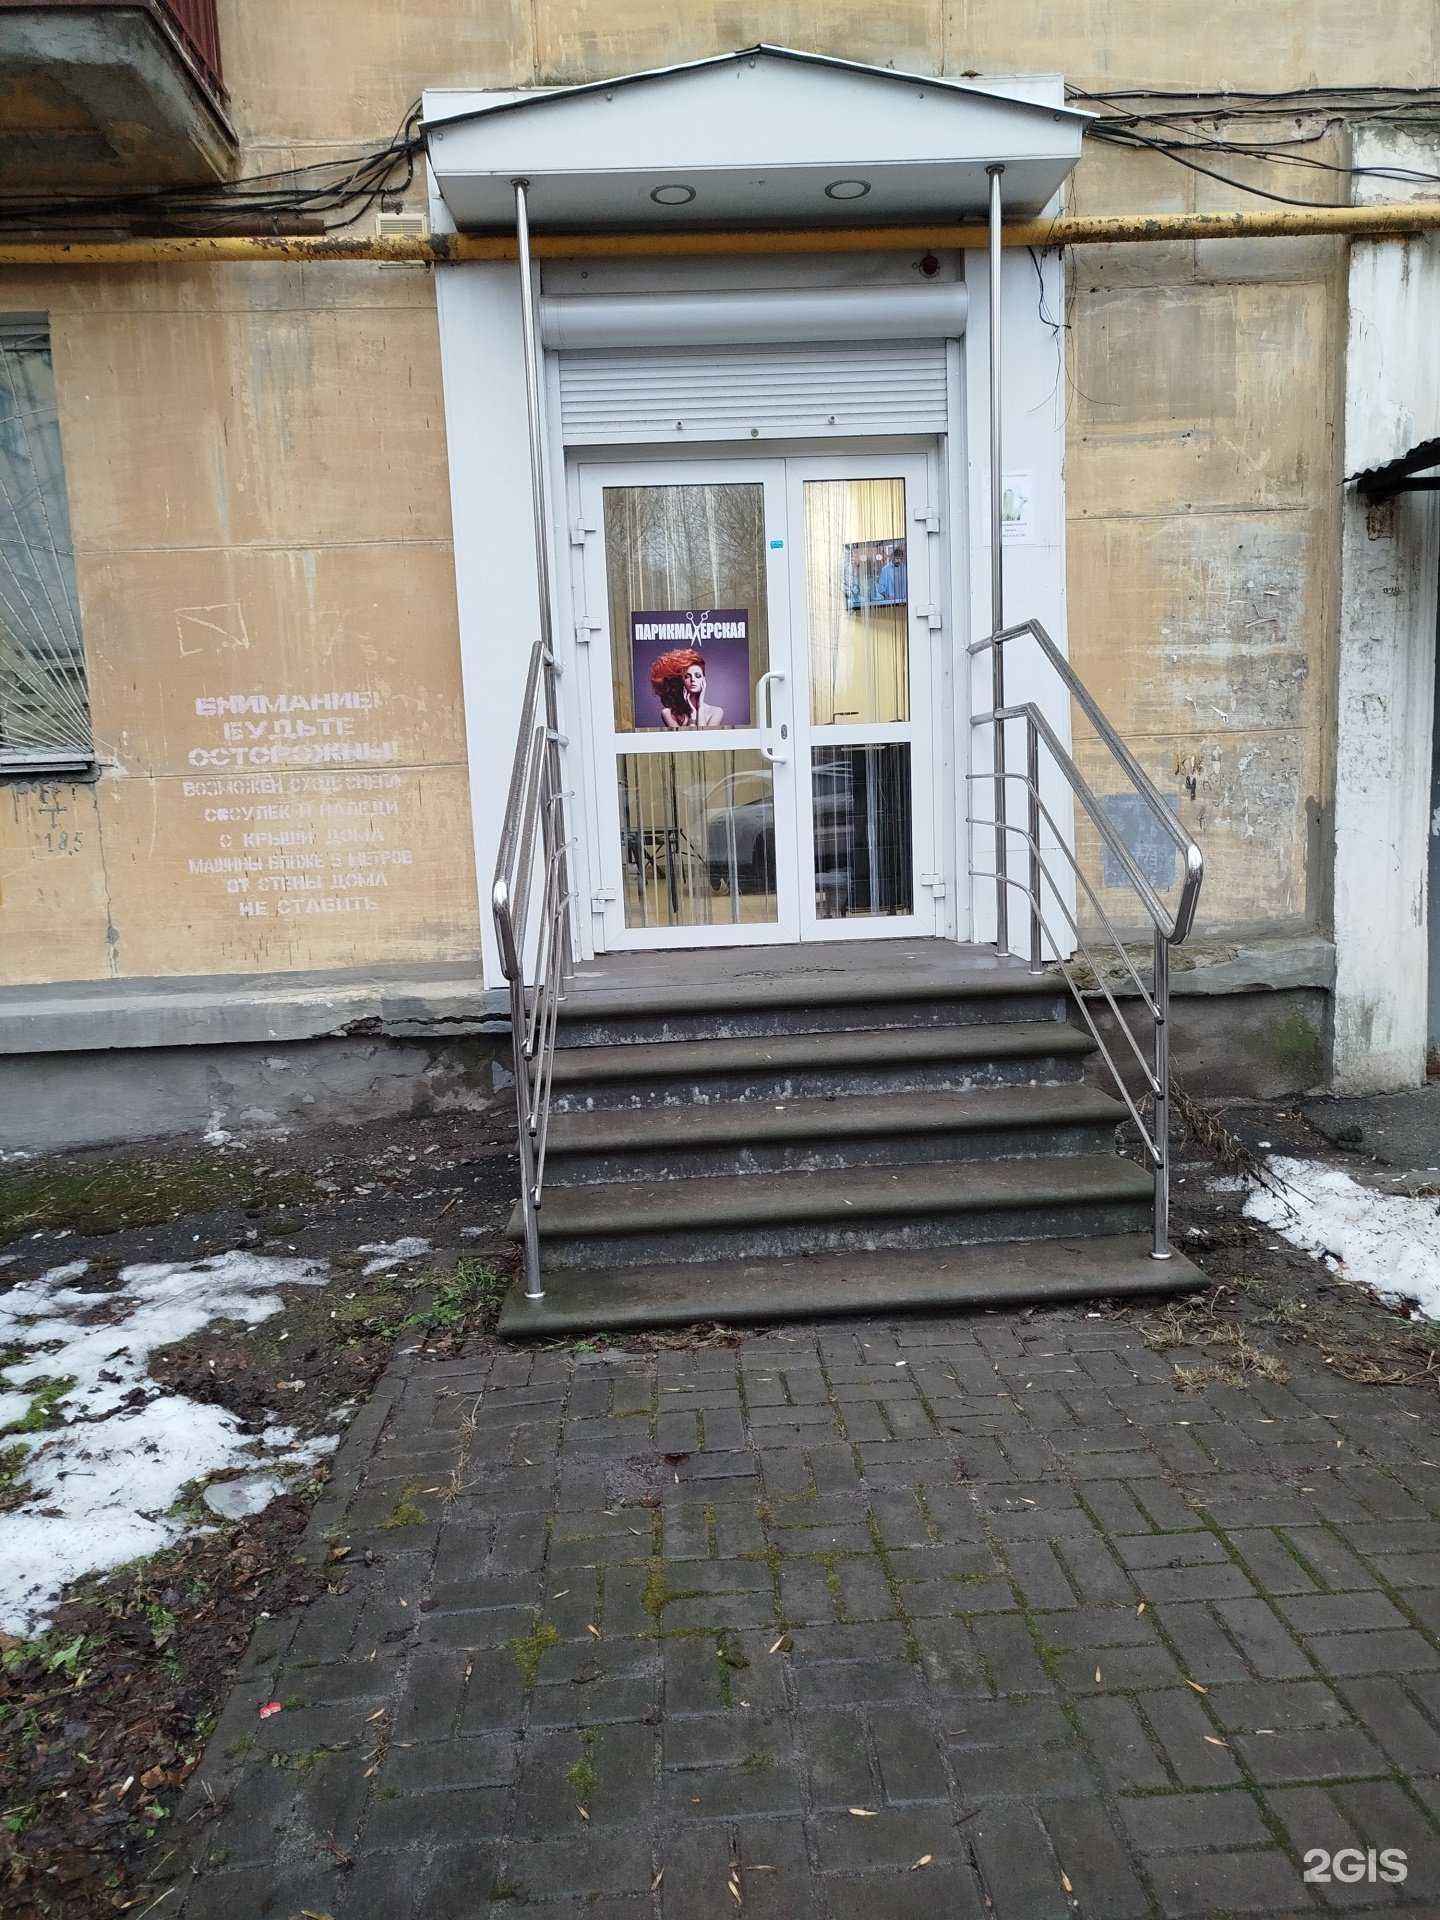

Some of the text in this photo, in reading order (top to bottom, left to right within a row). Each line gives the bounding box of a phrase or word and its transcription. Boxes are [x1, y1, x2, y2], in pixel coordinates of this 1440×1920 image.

[634, 619, 746, 643] ПАРИКМАХЕРСКАЯ
[223, 717, 354, 740] БУДЬТЕ
[218, 833, 232, 848] С
[226, 877, 249, 893] ОТ
[239, 896, 380, 917] НЕ СТАВИТЬ
